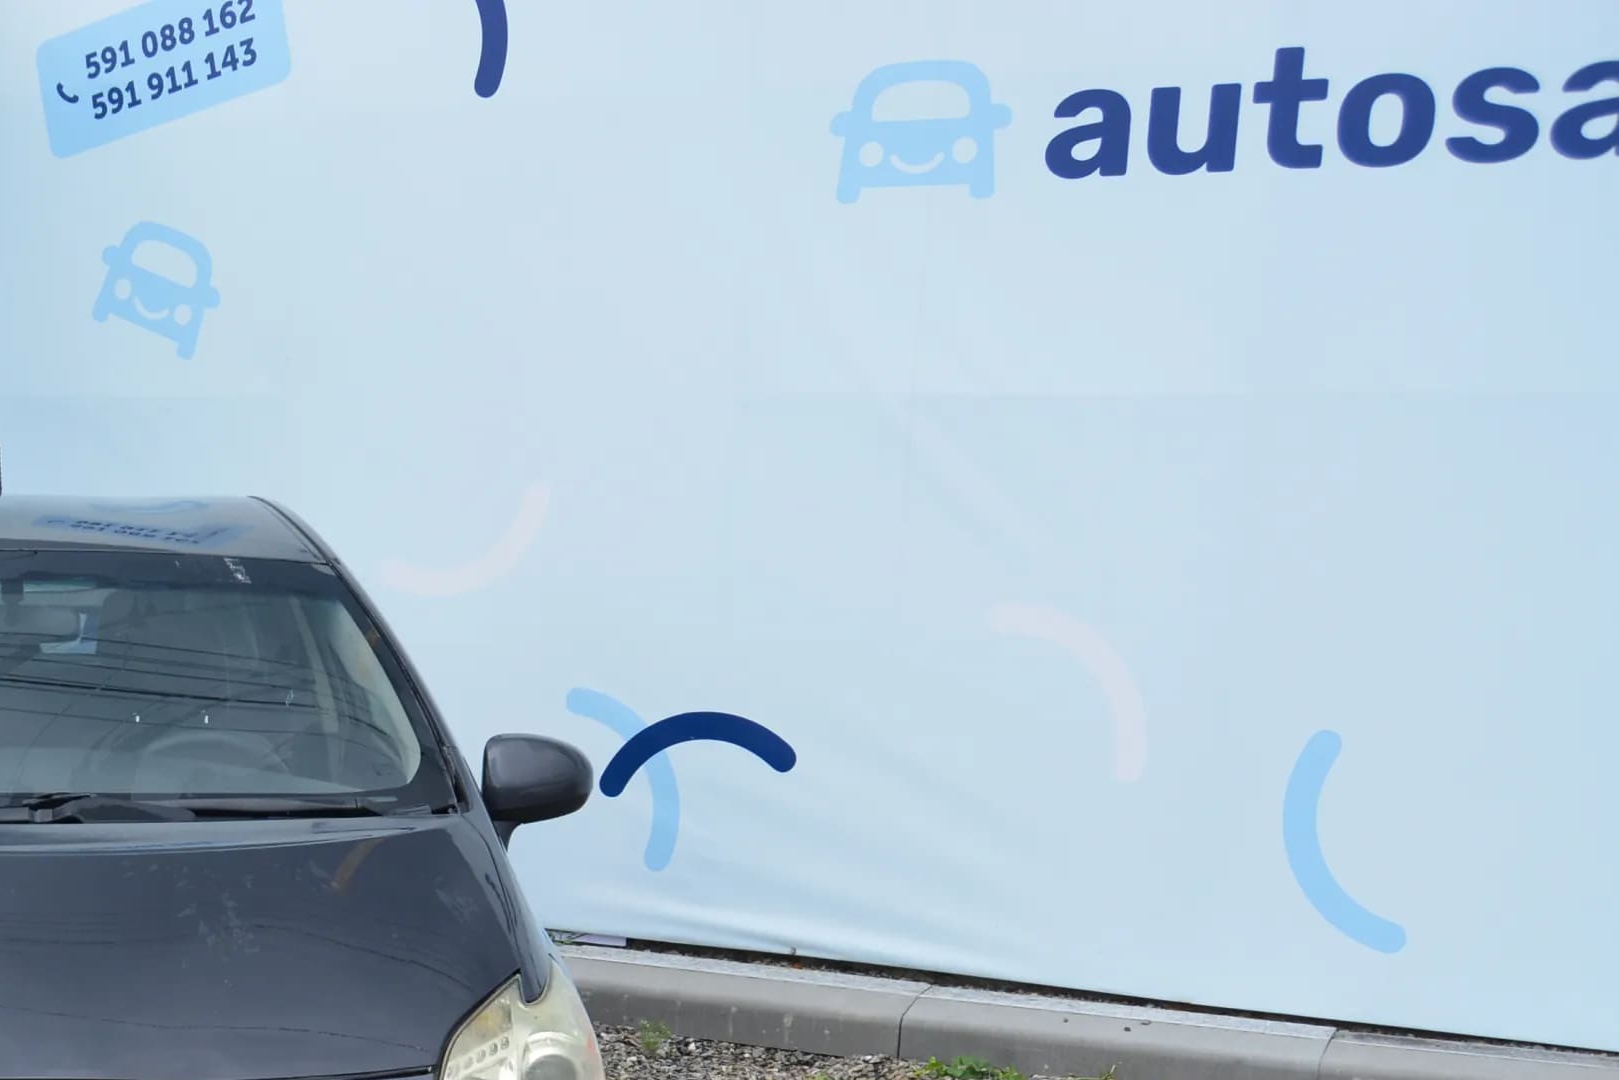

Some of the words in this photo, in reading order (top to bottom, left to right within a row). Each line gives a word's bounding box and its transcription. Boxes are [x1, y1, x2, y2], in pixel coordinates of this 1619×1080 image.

[85, 40, 135, 79] 591
[141, 17, 195, 58] 088
[202, 0, 256, 37] 162
[91, 80, 142, 120] 591
[147, 60, 199, 100] 911
[204, 37, 257, 81] 143
[1045, 46, 1619, 179] autosa
